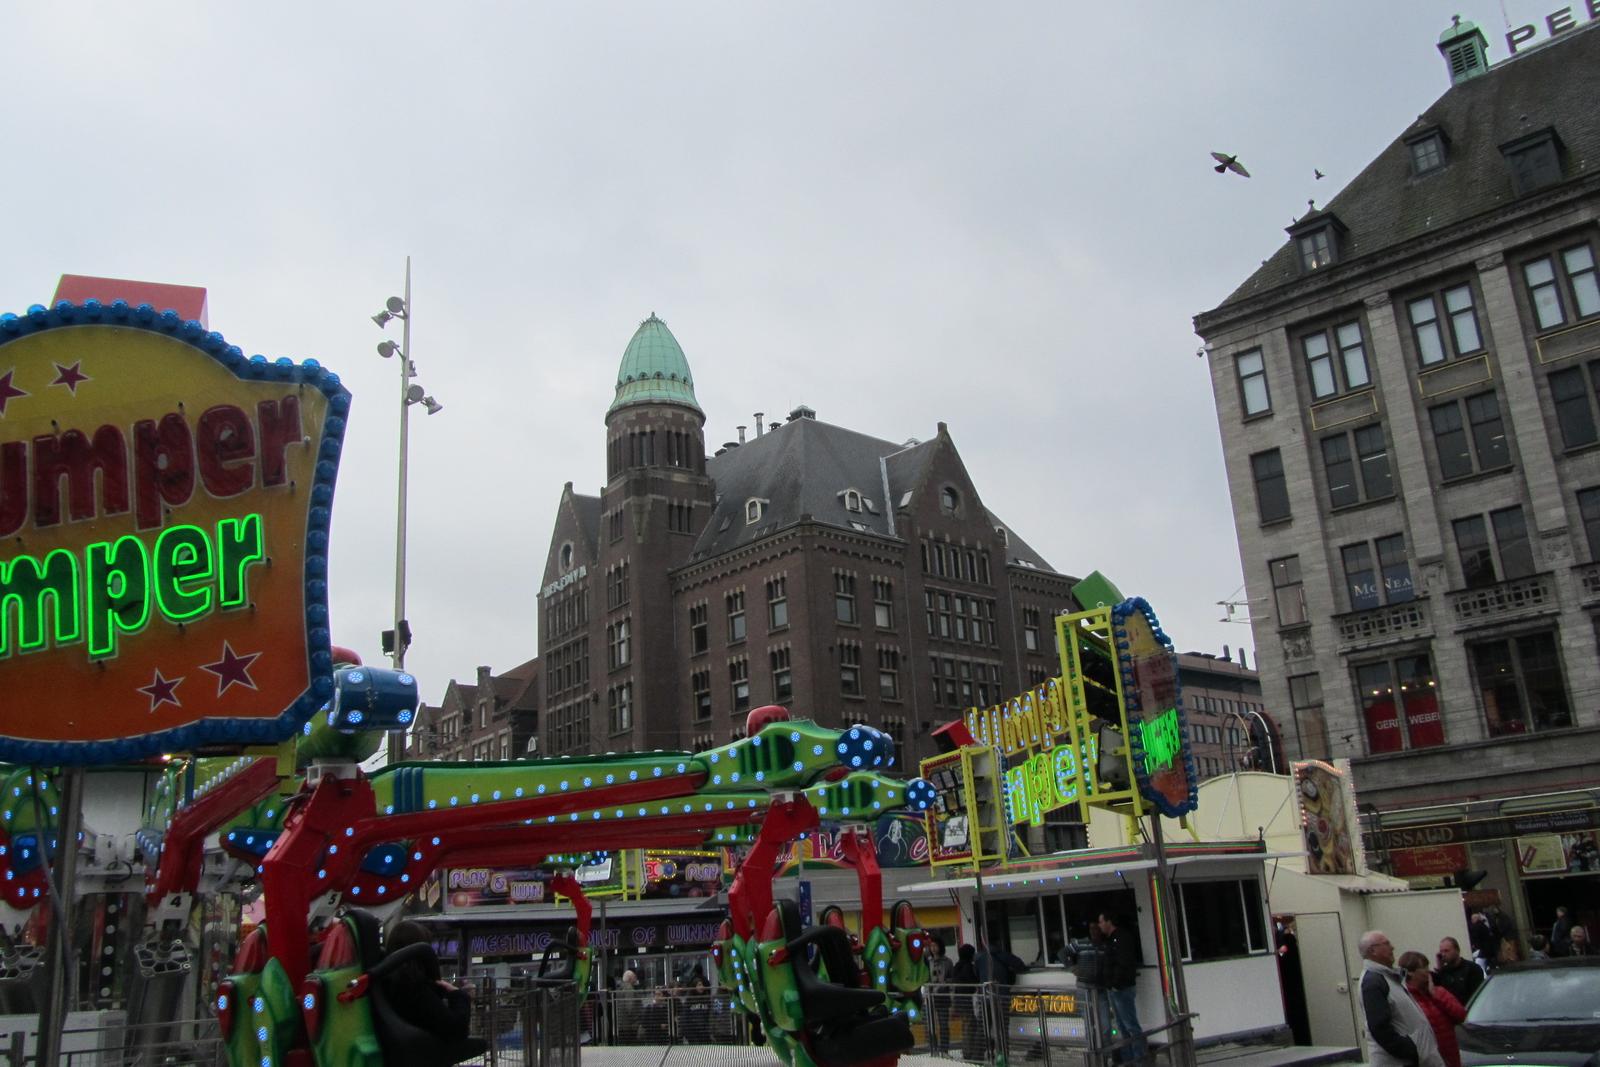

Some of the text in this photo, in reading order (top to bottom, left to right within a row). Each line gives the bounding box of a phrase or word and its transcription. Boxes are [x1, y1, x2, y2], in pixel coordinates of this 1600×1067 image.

[449, 869, 544, 901] PLAY & WIN
[169, 896, 182, 908] 4
[322, 894, 333, 906] 5
[471, 931, 552, 954] MEETING
[631, 926, 656, 945] OF
